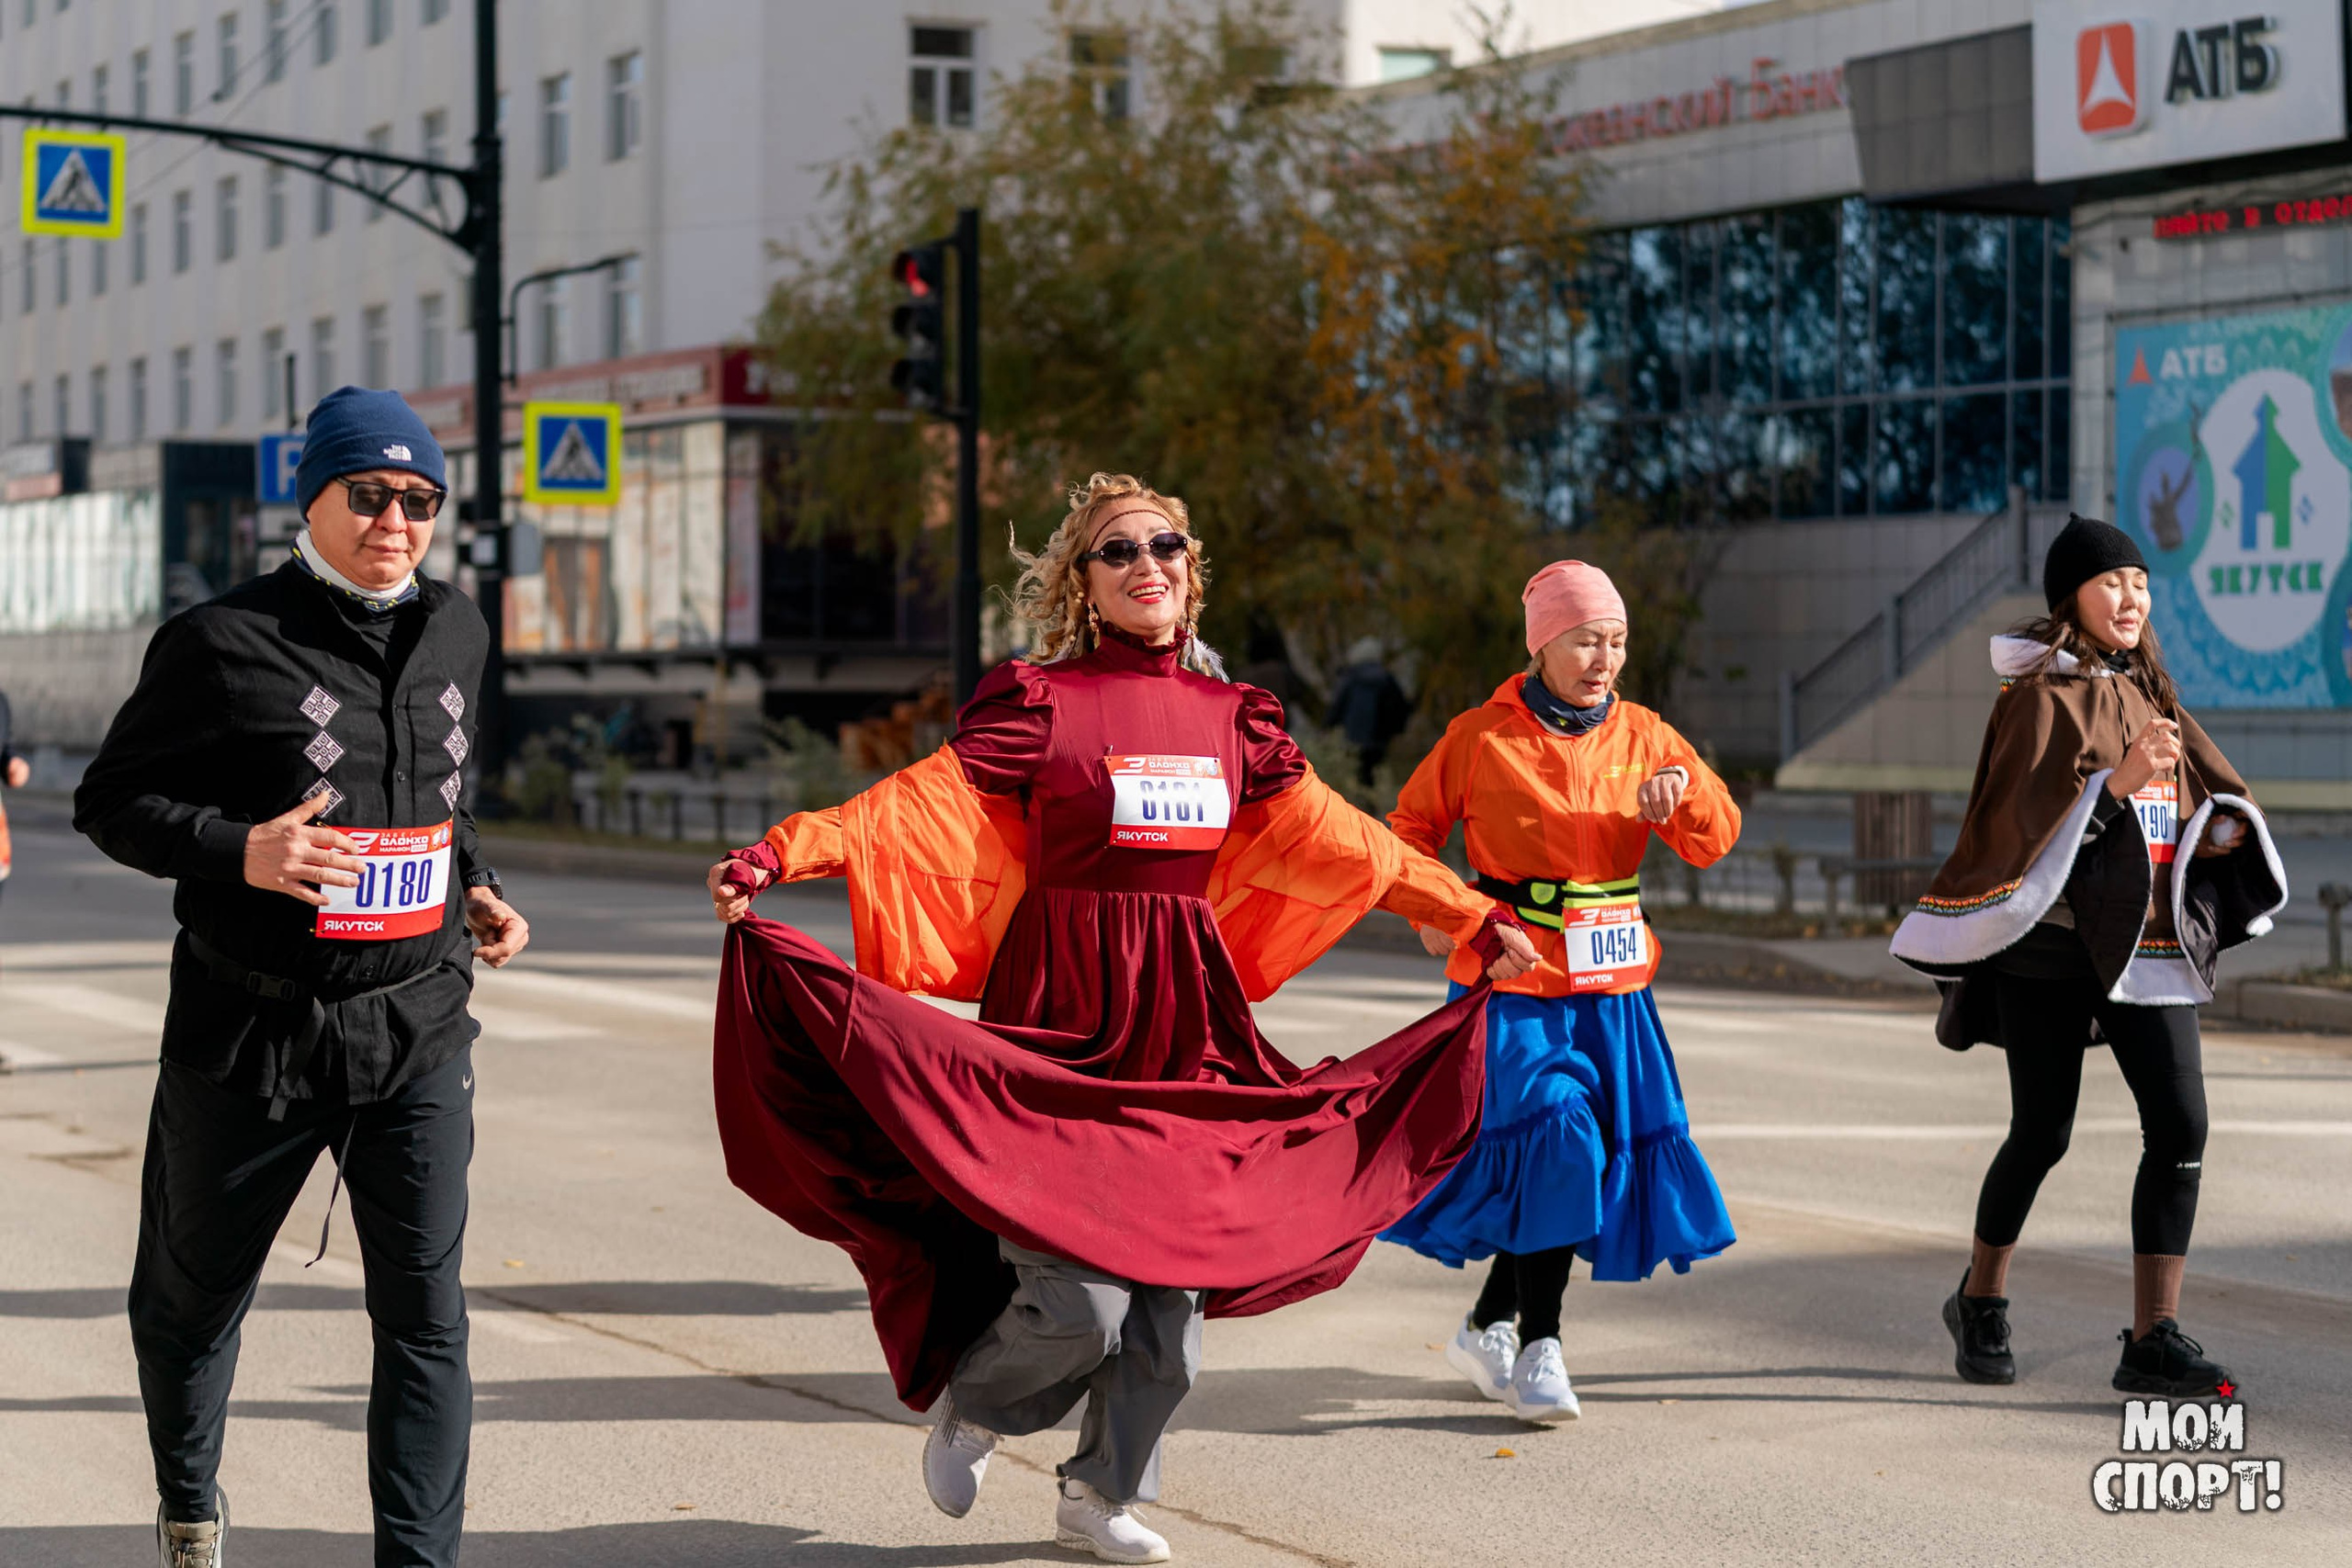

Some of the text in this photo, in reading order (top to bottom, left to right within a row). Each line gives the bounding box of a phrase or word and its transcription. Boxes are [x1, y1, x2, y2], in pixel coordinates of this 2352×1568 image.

[2165, 16, 2271, 104] АТБ
[2161, 344, 2228, 379] АТБ
[2209, 562, 2323, 595] ЯКУТСК
[379, 836, 429, 846] ОЛОНХО
[1117, 830, 1169, 842] ЯКУТСК
[355, 858, 433, 908] 0180
[324, 919, 385, 932] ЯКУТСК
[1590, 926, 1636, 965] 0454
[1575, 974, 1614, 987] ЯКУТСК
